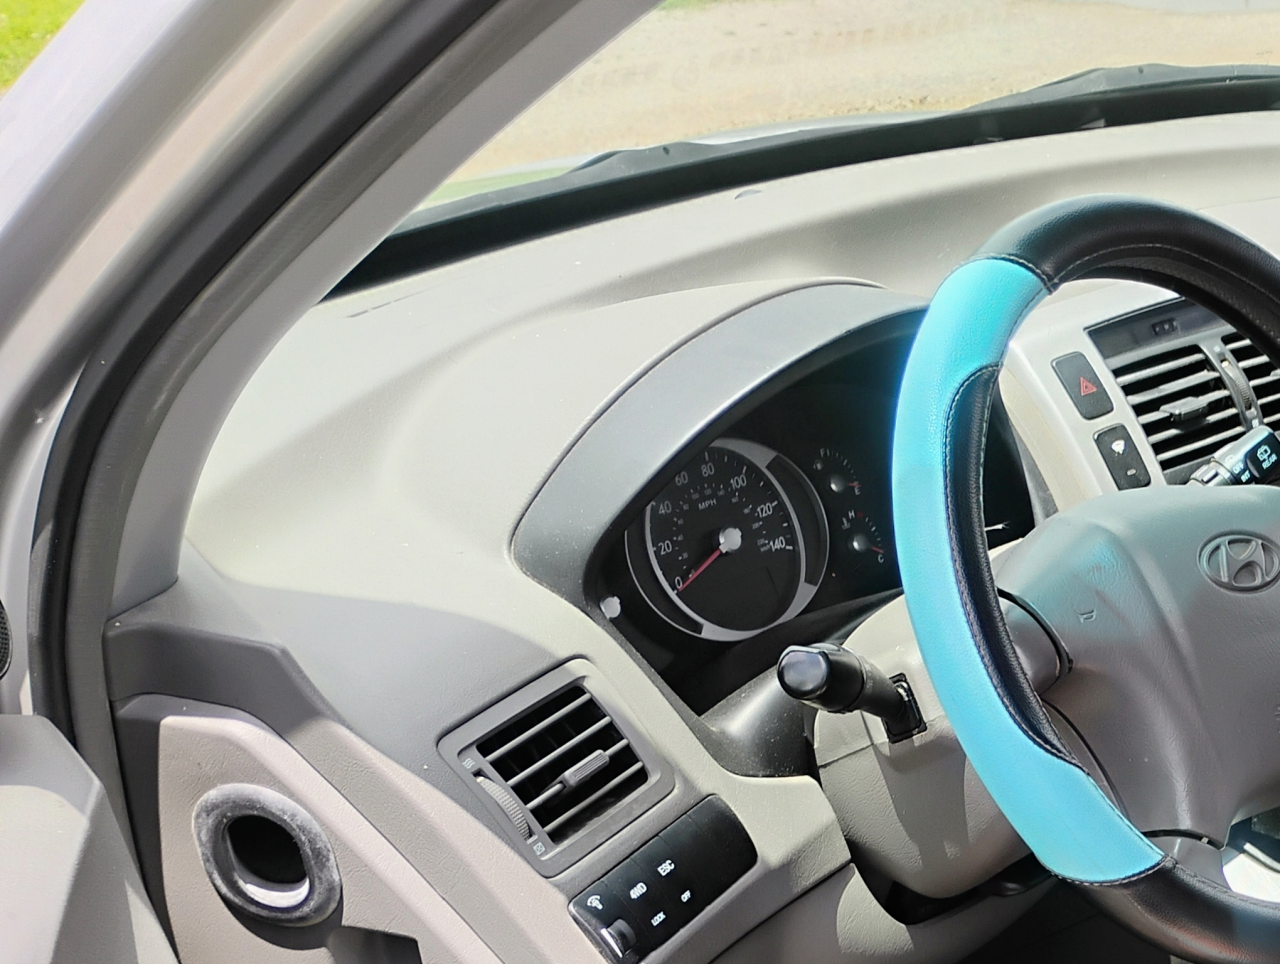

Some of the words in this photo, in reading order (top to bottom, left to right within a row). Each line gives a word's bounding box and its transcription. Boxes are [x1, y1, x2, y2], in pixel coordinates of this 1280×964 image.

[1262, 453, 1278, 470] REAR
[675, 471, 688, 486] 60
[701, 463, 715, 478] 80
[730, 474, 747, 490] 100
[658, 500, 672, 516] 40
[698, 498, 717, 511] MPH
[757, 503, 773, 518] 120
[658, 540, 672, 556] 20
[770, 536, 786, 552] 140
[675, 576, 683, 589] 0
[657, 859, 675, 877] ESC
[629, 881, 648, 900] 4WD
[680, 889, 692, 903] OFF
[651, 911, 666, 927] LOCK
